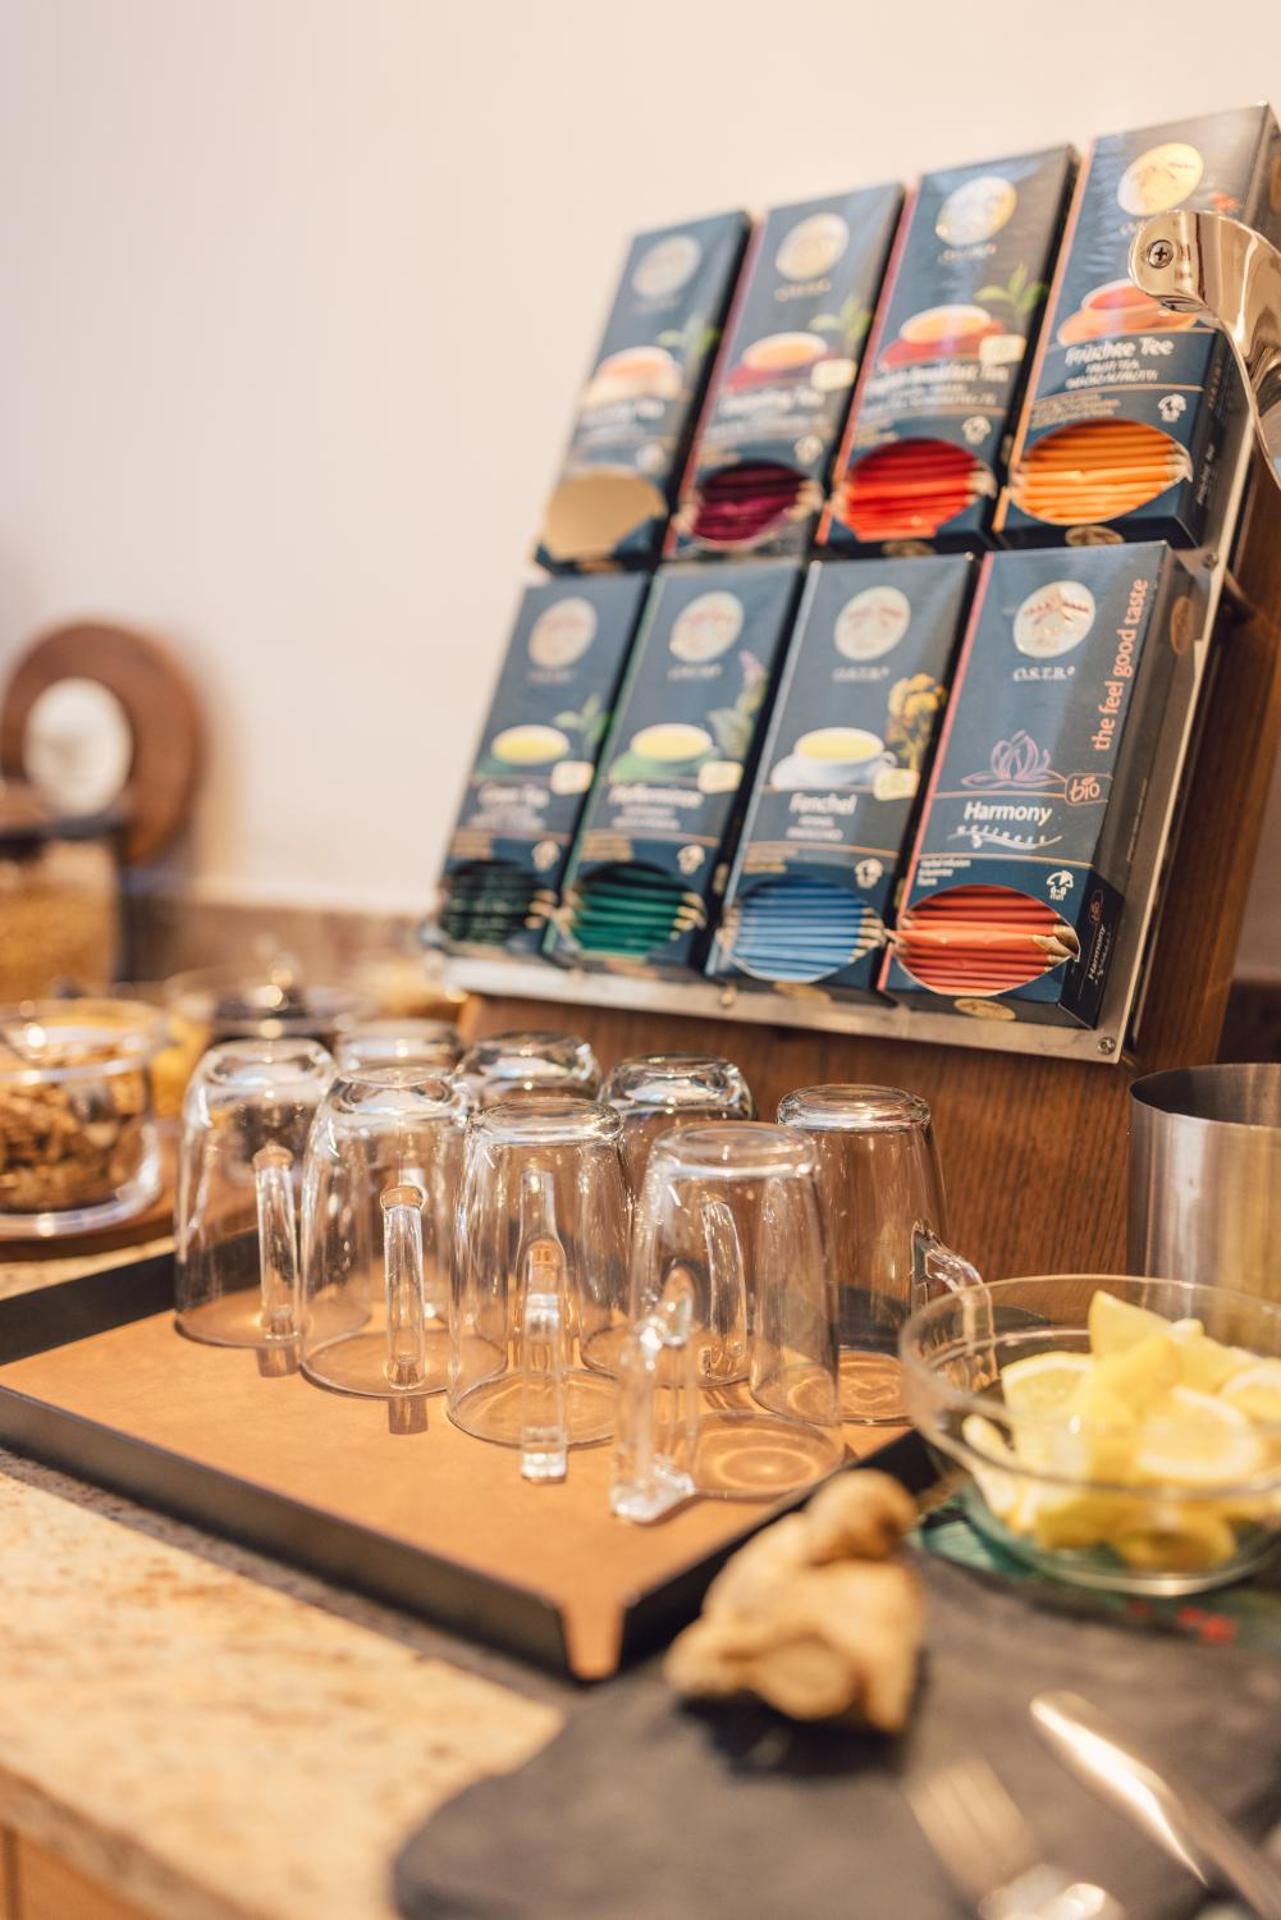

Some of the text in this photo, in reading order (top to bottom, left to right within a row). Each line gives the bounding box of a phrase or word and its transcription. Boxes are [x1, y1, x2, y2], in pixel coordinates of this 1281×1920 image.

[1139, 336, 1174, 356] Tee
[1091, 578, 1149, 751] the feel good taste
[1071, 776, 1101, 802] bio
[964, 801, 1053, 827] Harmony
